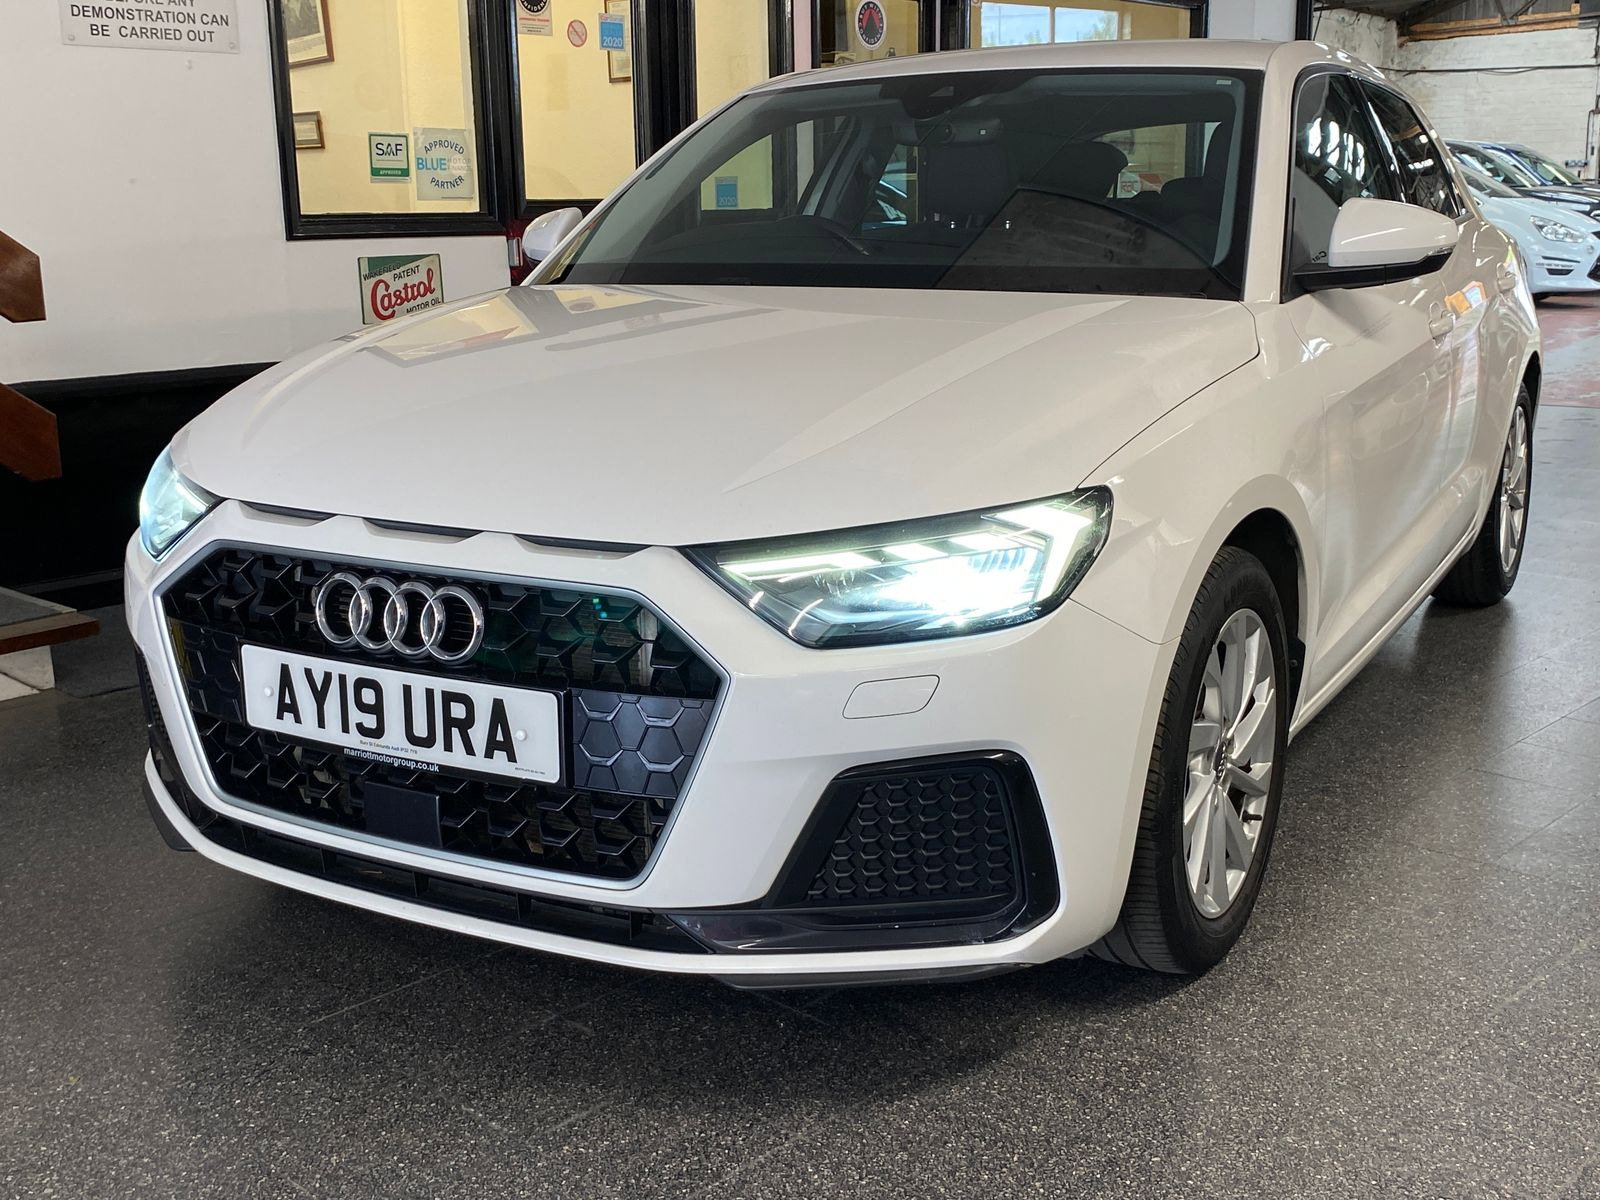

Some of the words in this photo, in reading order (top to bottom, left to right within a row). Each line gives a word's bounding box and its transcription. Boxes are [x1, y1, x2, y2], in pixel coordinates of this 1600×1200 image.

[70, 4, 196, 24] DEMONSTRATION
[200, 13, 229, 27] CAN
[90, 24, 111, 37] BE
[118, 25, 183, 41] CARRIED
[186, 30, 215, 43] OUT
[602, 36, 623, 48] 2020
[375, 142, 403, 157] SAF
[424, 140, 465, 155] APPROVED
[416, 157, 447, 171] BLUE
[430, 175, 465, 190] PARTNER
[393, 265, 420, 281] PATENT
[371, 268, 436, 320] Castrol
[430, 297, 441, 307] OIL
[276, 663, 386, 740] AY19
[402, 684, 518, 764] URA
[343, 748, 440, 772] marriottmotorgroup.co.uk
